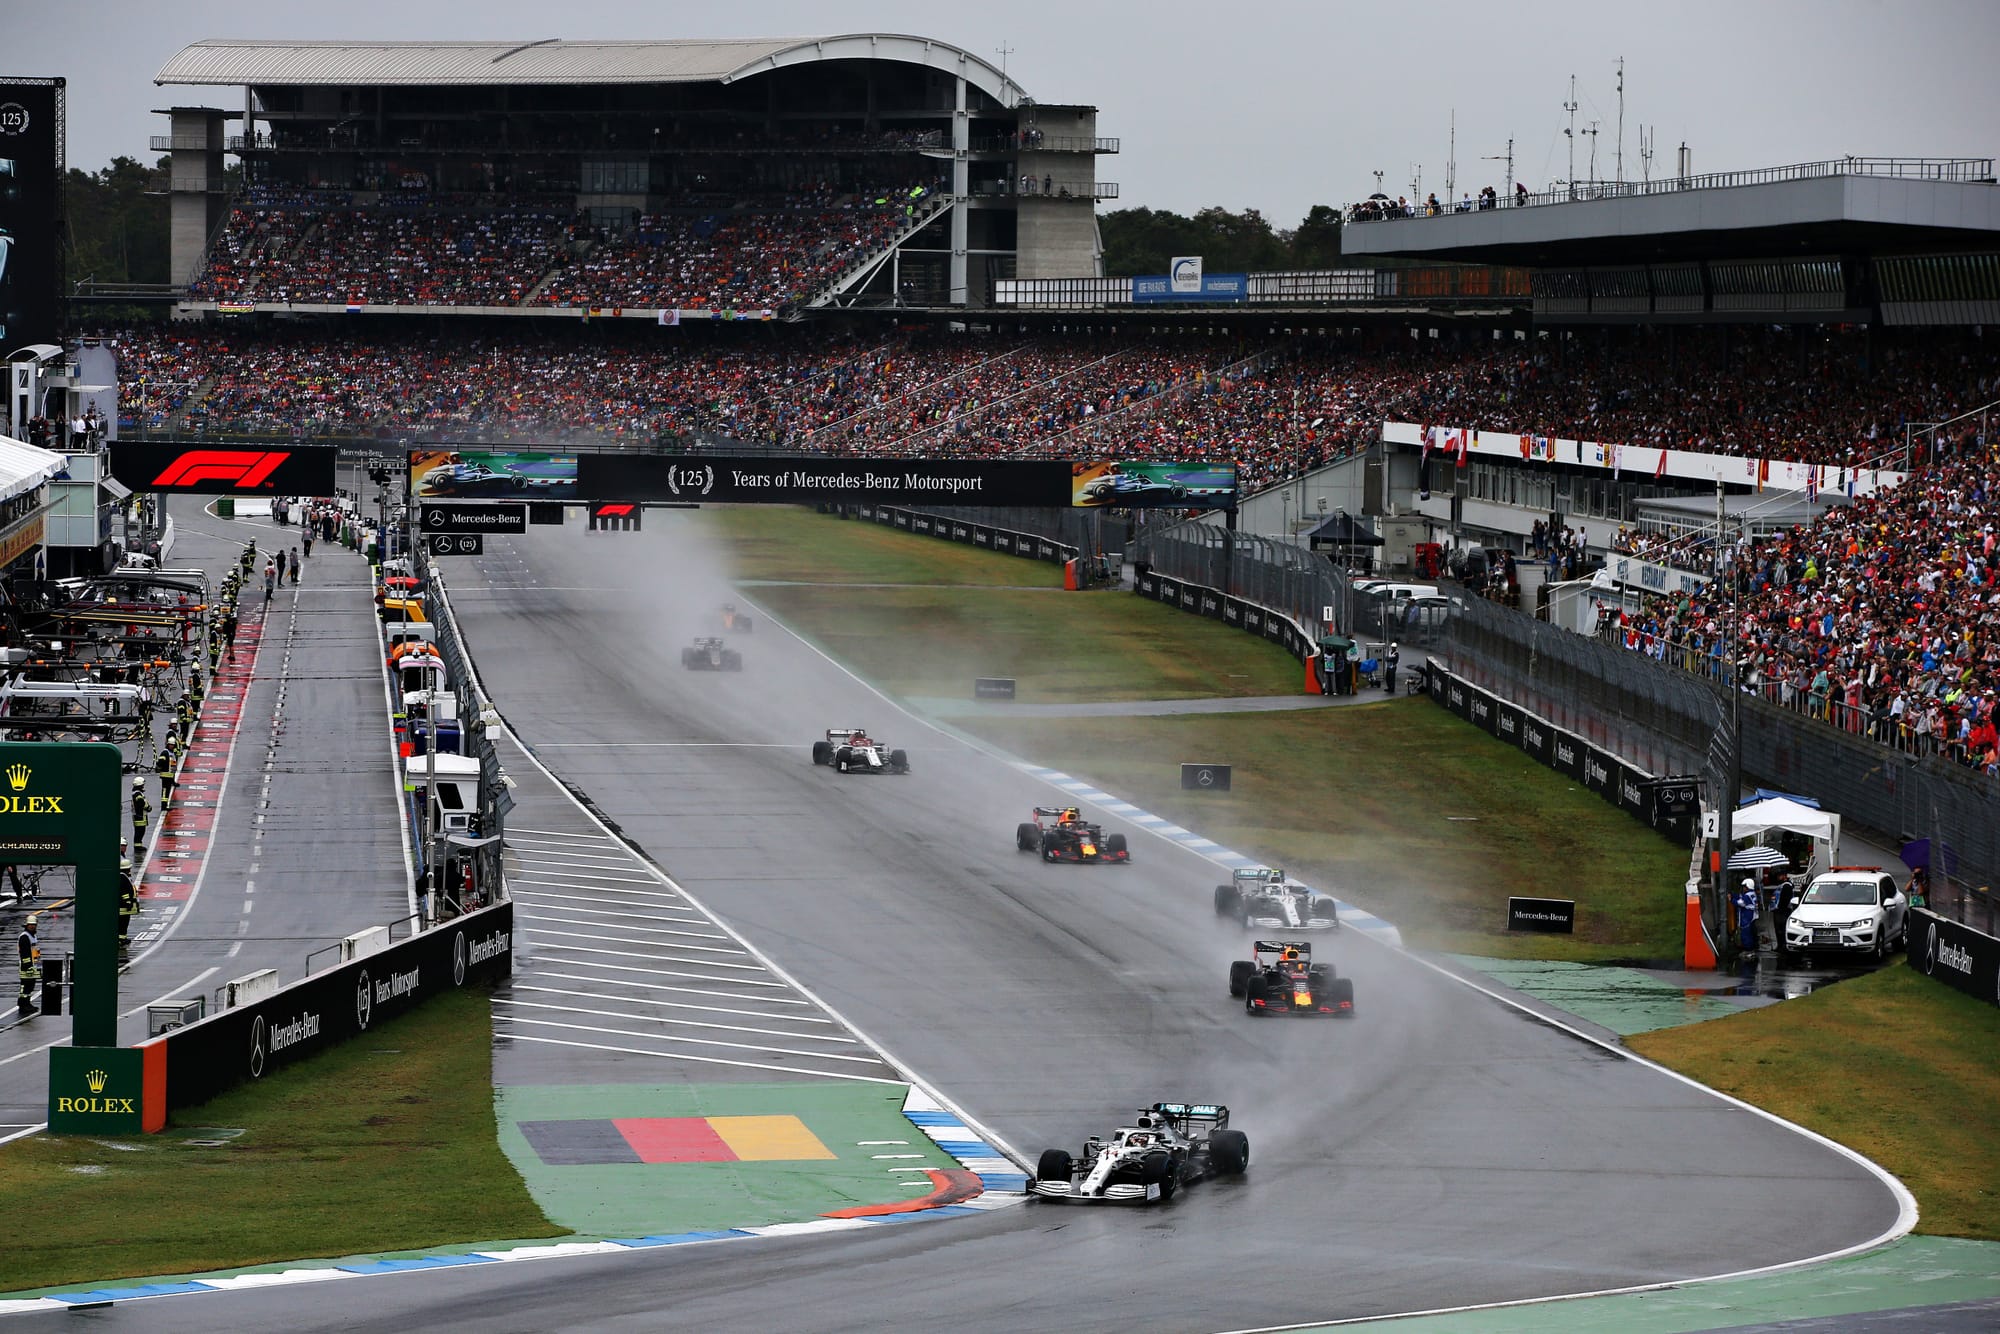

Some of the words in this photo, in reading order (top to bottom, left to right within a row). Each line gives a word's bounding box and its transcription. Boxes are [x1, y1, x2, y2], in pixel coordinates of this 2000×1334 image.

[2, 113, 21, 125] 125
[679, 470, 703, 486] 125
[732, 470, 771, 488] Years
[775, 470, 790, 488] of
[792, 471, 900, 490] Mercedes-Benz
[904, 473, 983, 494] Motorsport
[451, 513, 521, 524] Mercedes-Benz
[463, 540, 473, 548] 125
[1708, 818, 1714, 833] 2
[39, 842, 61, 850] 2019
[1514, 911, 1568, 922] Mercedes-Benz
[469, 930, 509, 966] Mercedes-Benz
[1938, 937, 1973, 975] Mercedes-Benz
[376, 979, 391, 1005] Years
[391, 965, 419, 997] Motorsport
[270, 1011, 320, 1053] Mercedes-Benz
[57, 1097, 135, 1113] ROLEX
